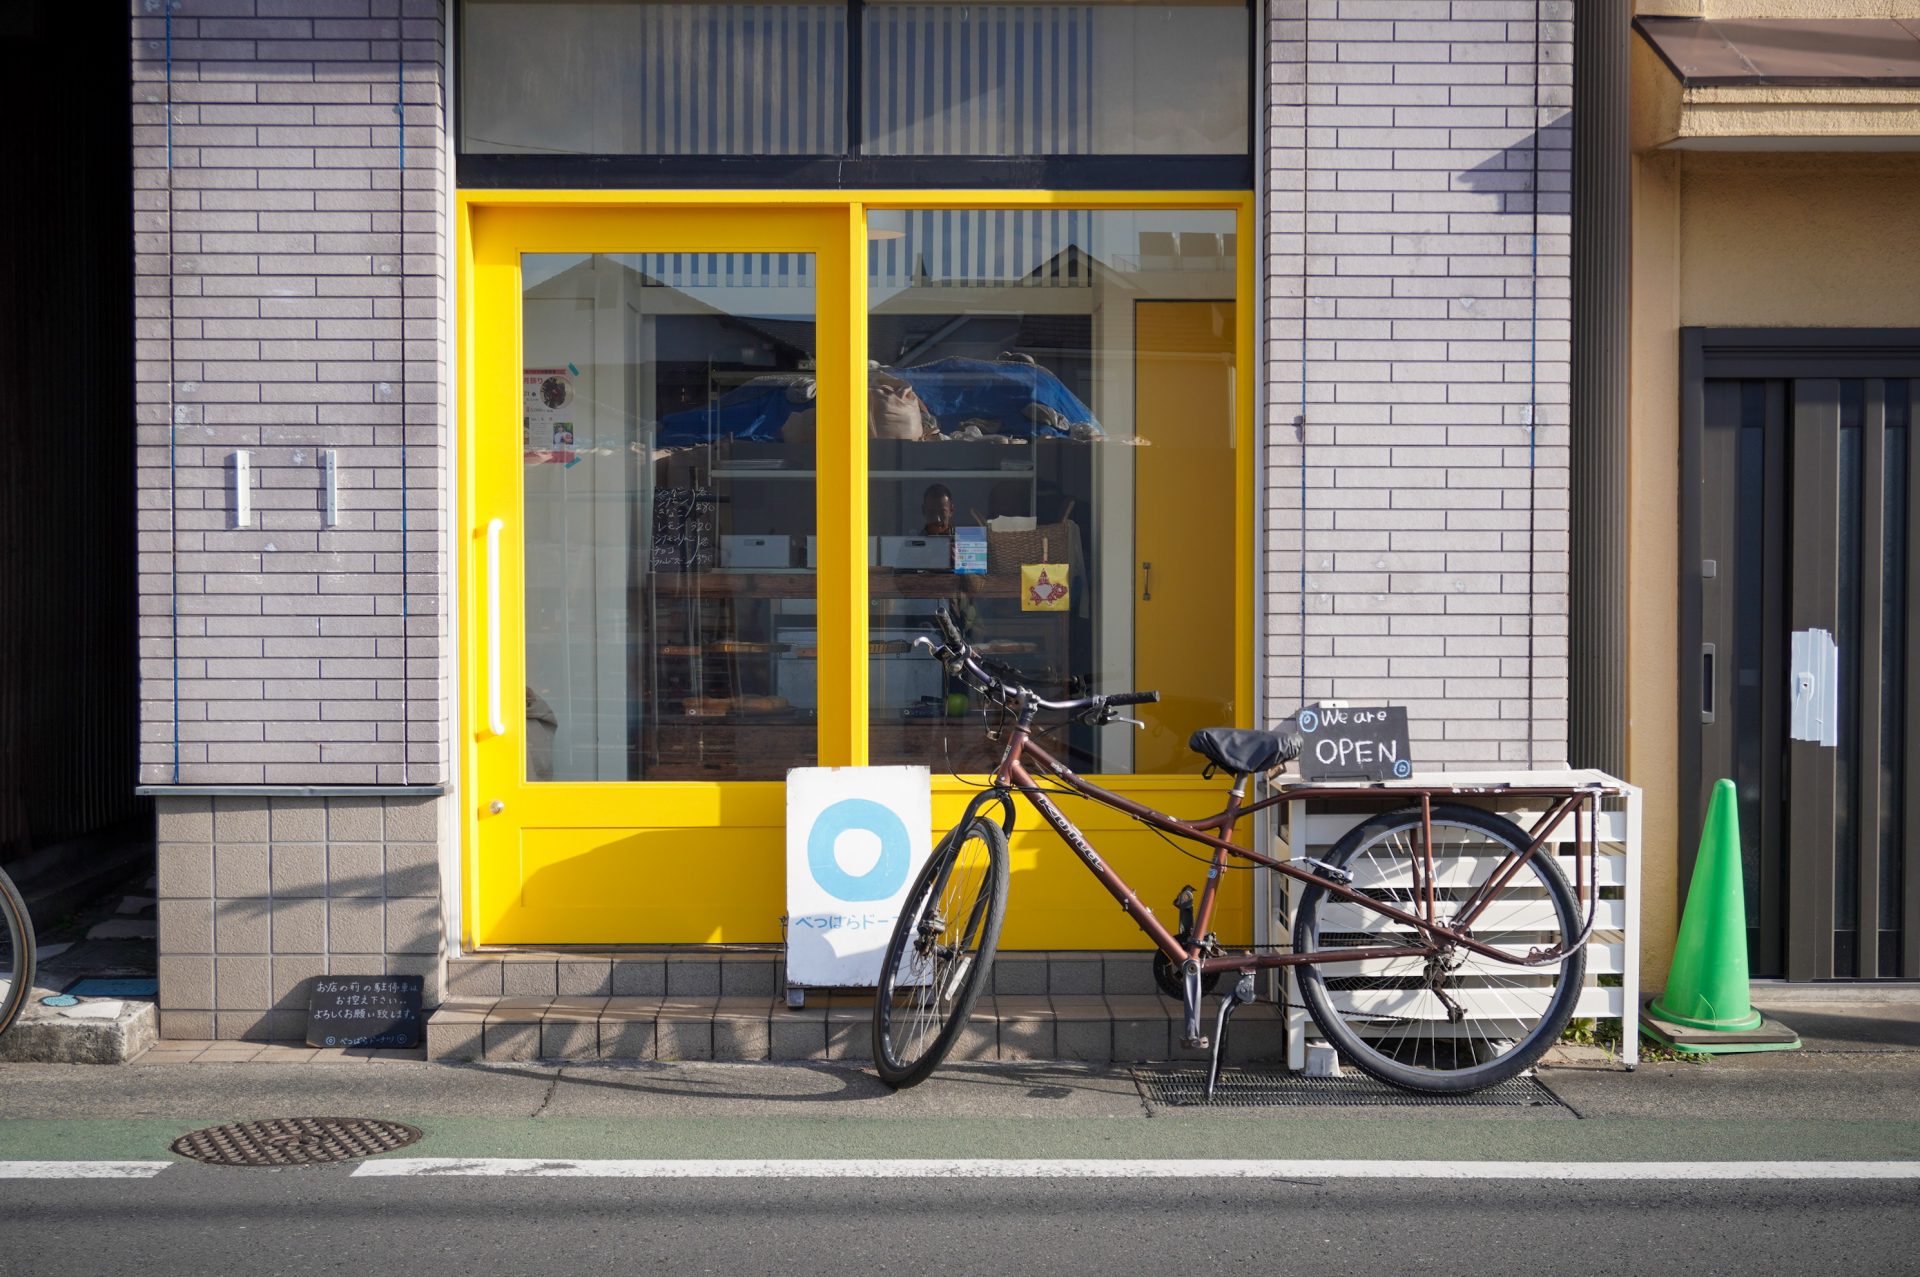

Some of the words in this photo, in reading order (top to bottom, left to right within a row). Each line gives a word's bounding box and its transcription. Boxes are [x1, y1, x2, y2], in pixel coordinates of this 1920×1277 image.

[1321, 708, 1349, 727] We
[1353, 710, 1388, 724] are
[1315, 738, 1397, 767] OPEN
[795, 913, 918, 930] べつばらドー
